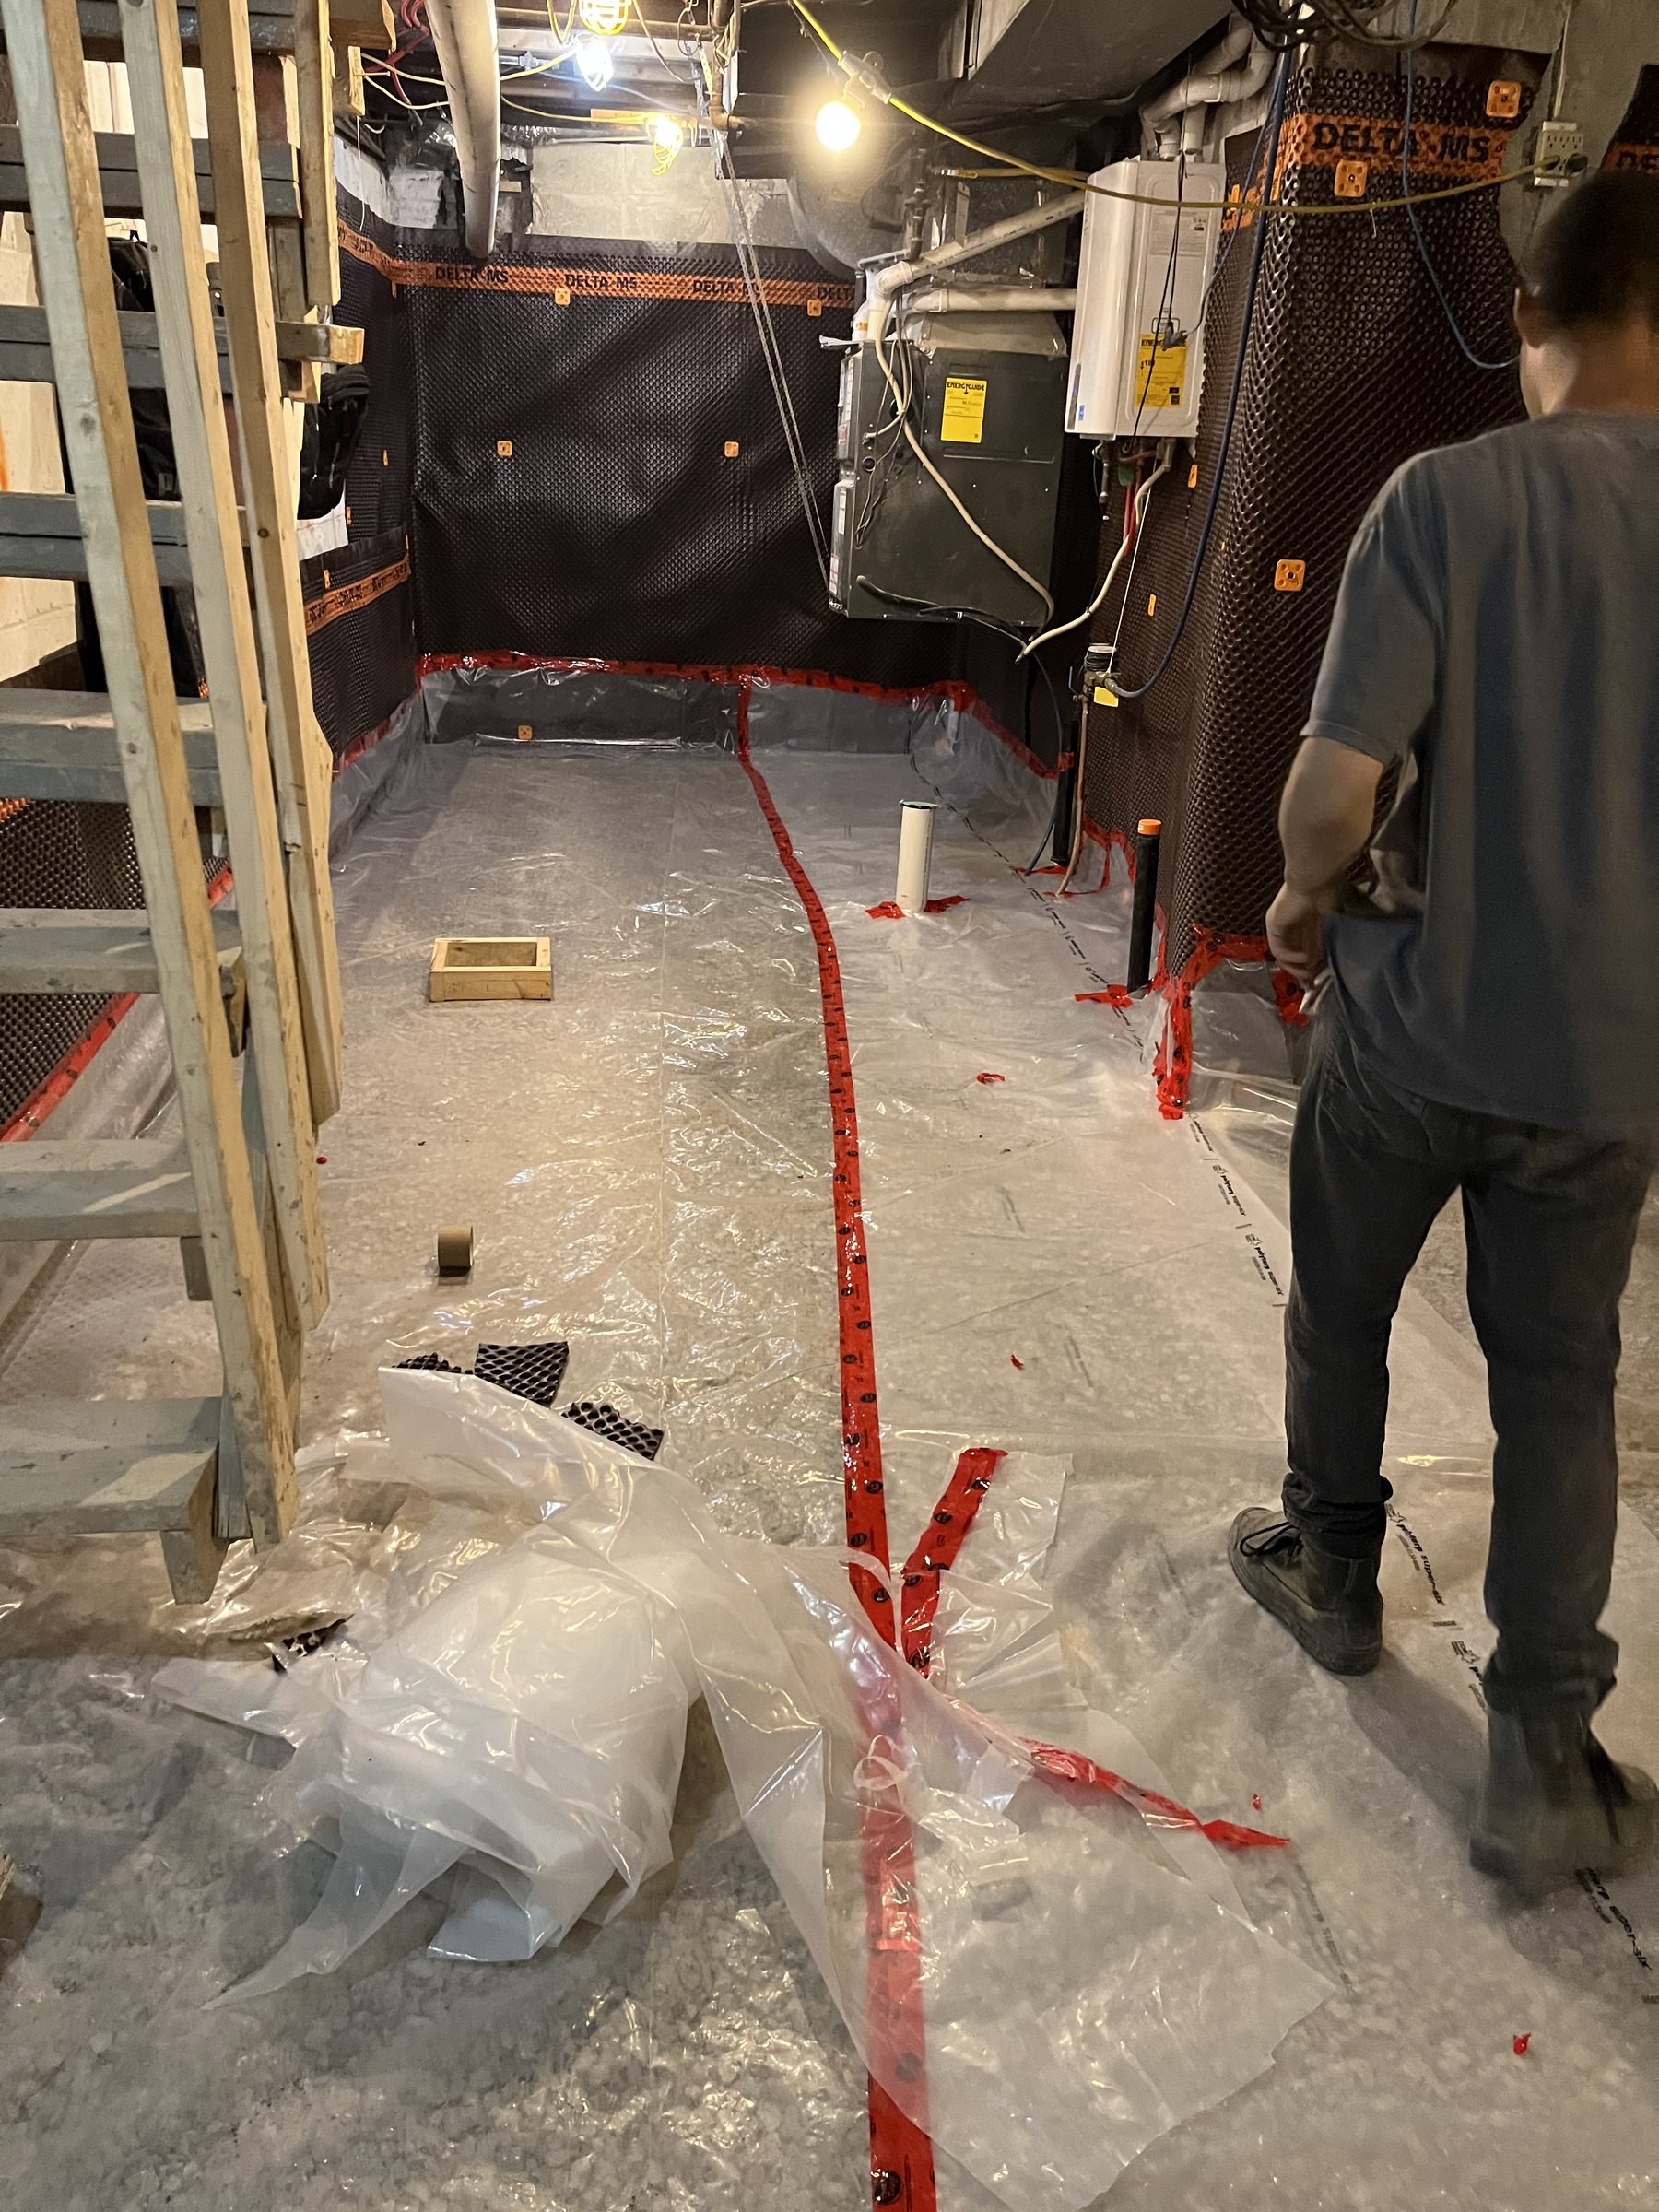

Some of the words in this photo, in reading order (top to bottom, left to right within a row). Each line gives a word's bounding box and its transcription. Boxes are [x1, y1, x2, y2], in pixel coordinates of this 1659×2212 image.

[1312, 122, 1418, 158] DELTA
[1439, 132, 1490, 164] MS
[565, 273, 609, 289] DELTA
[692, 279, 735, 294] DELTA
[1420, 1554, 1445, 1606] super-six
